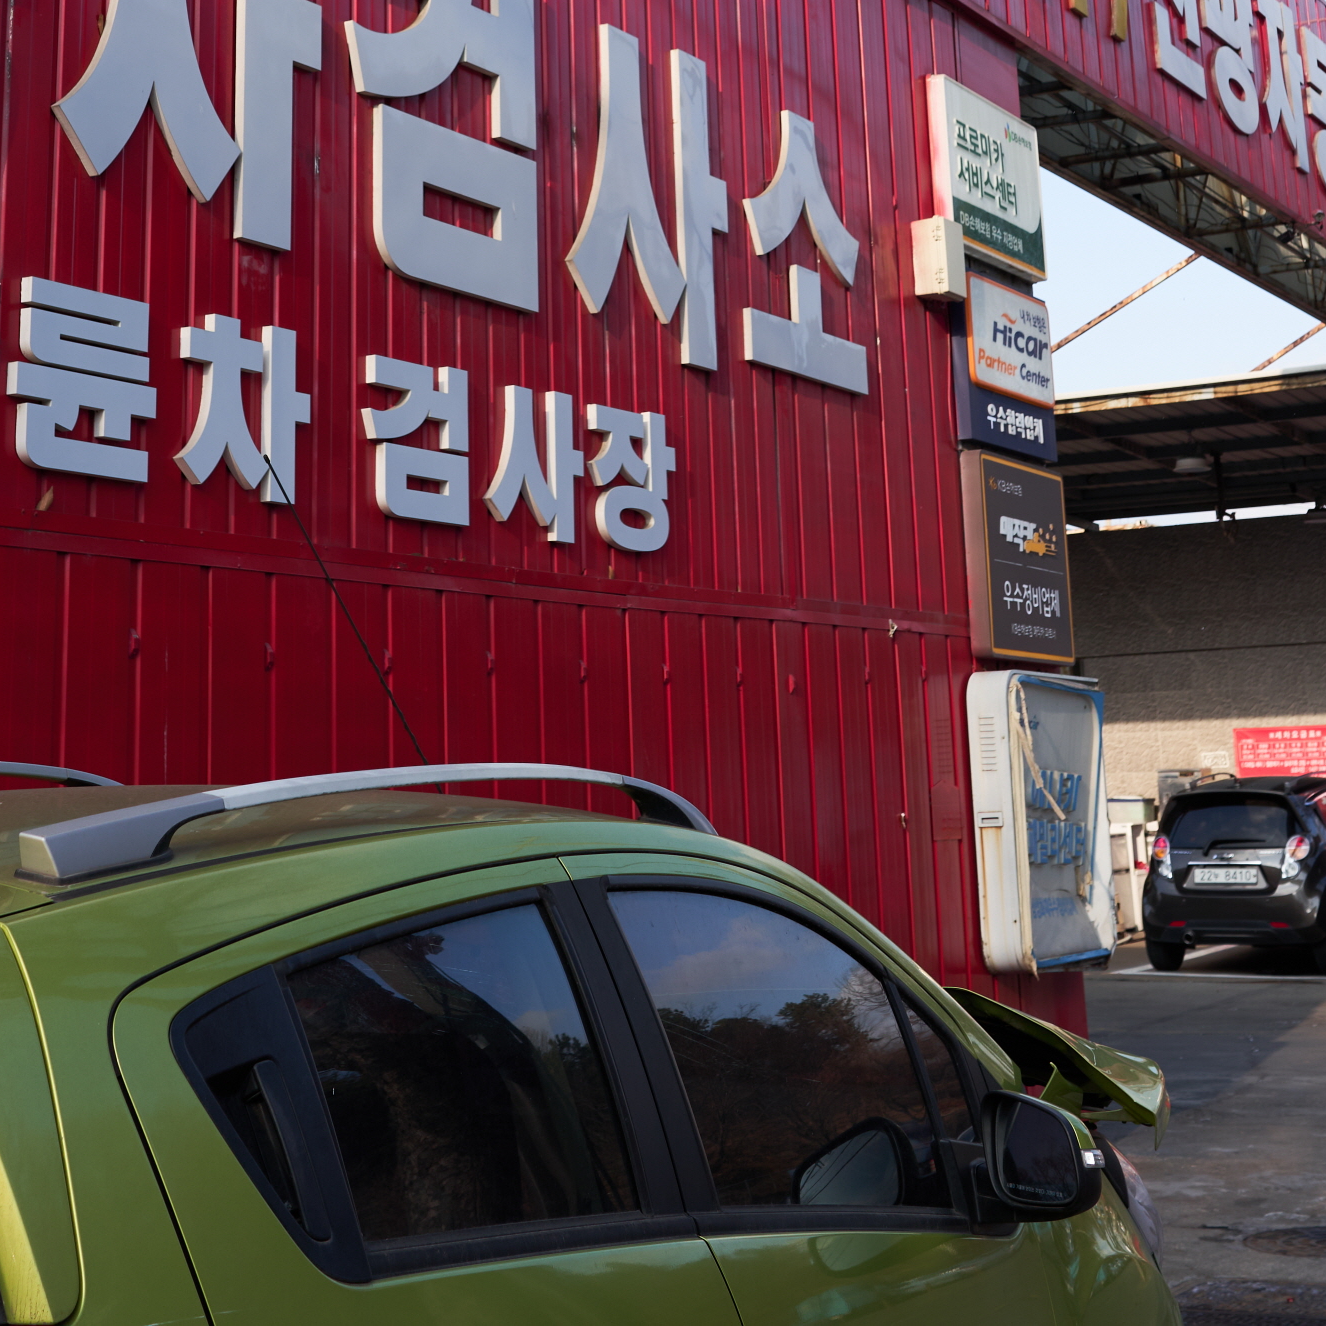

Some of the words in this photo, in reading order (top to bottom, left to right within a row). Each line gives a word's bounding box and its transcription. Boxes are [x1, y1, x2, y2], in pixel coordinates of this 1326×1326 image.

[954, 117, 1005, 174] 프로미카
[957, 154, 1018, 216] 서비스센터
[960, 211, 991, 238] DB손해보험
[992, 225, 1003, 243] 우수
[1003, 231, 1024, 254] 지정업체
[992, 320, 1049, 362] Hicar
[978, 347, 1018, 377] Partner
[1019, 363, 1051, 390] Center
[987, 403, 1045, 445] 우수협력업체
[362, 354, 676, 553] 검사장
[1003, 579, 1061, 618] 우수정비업체
[1225, 870, 1252, 882] 8410
